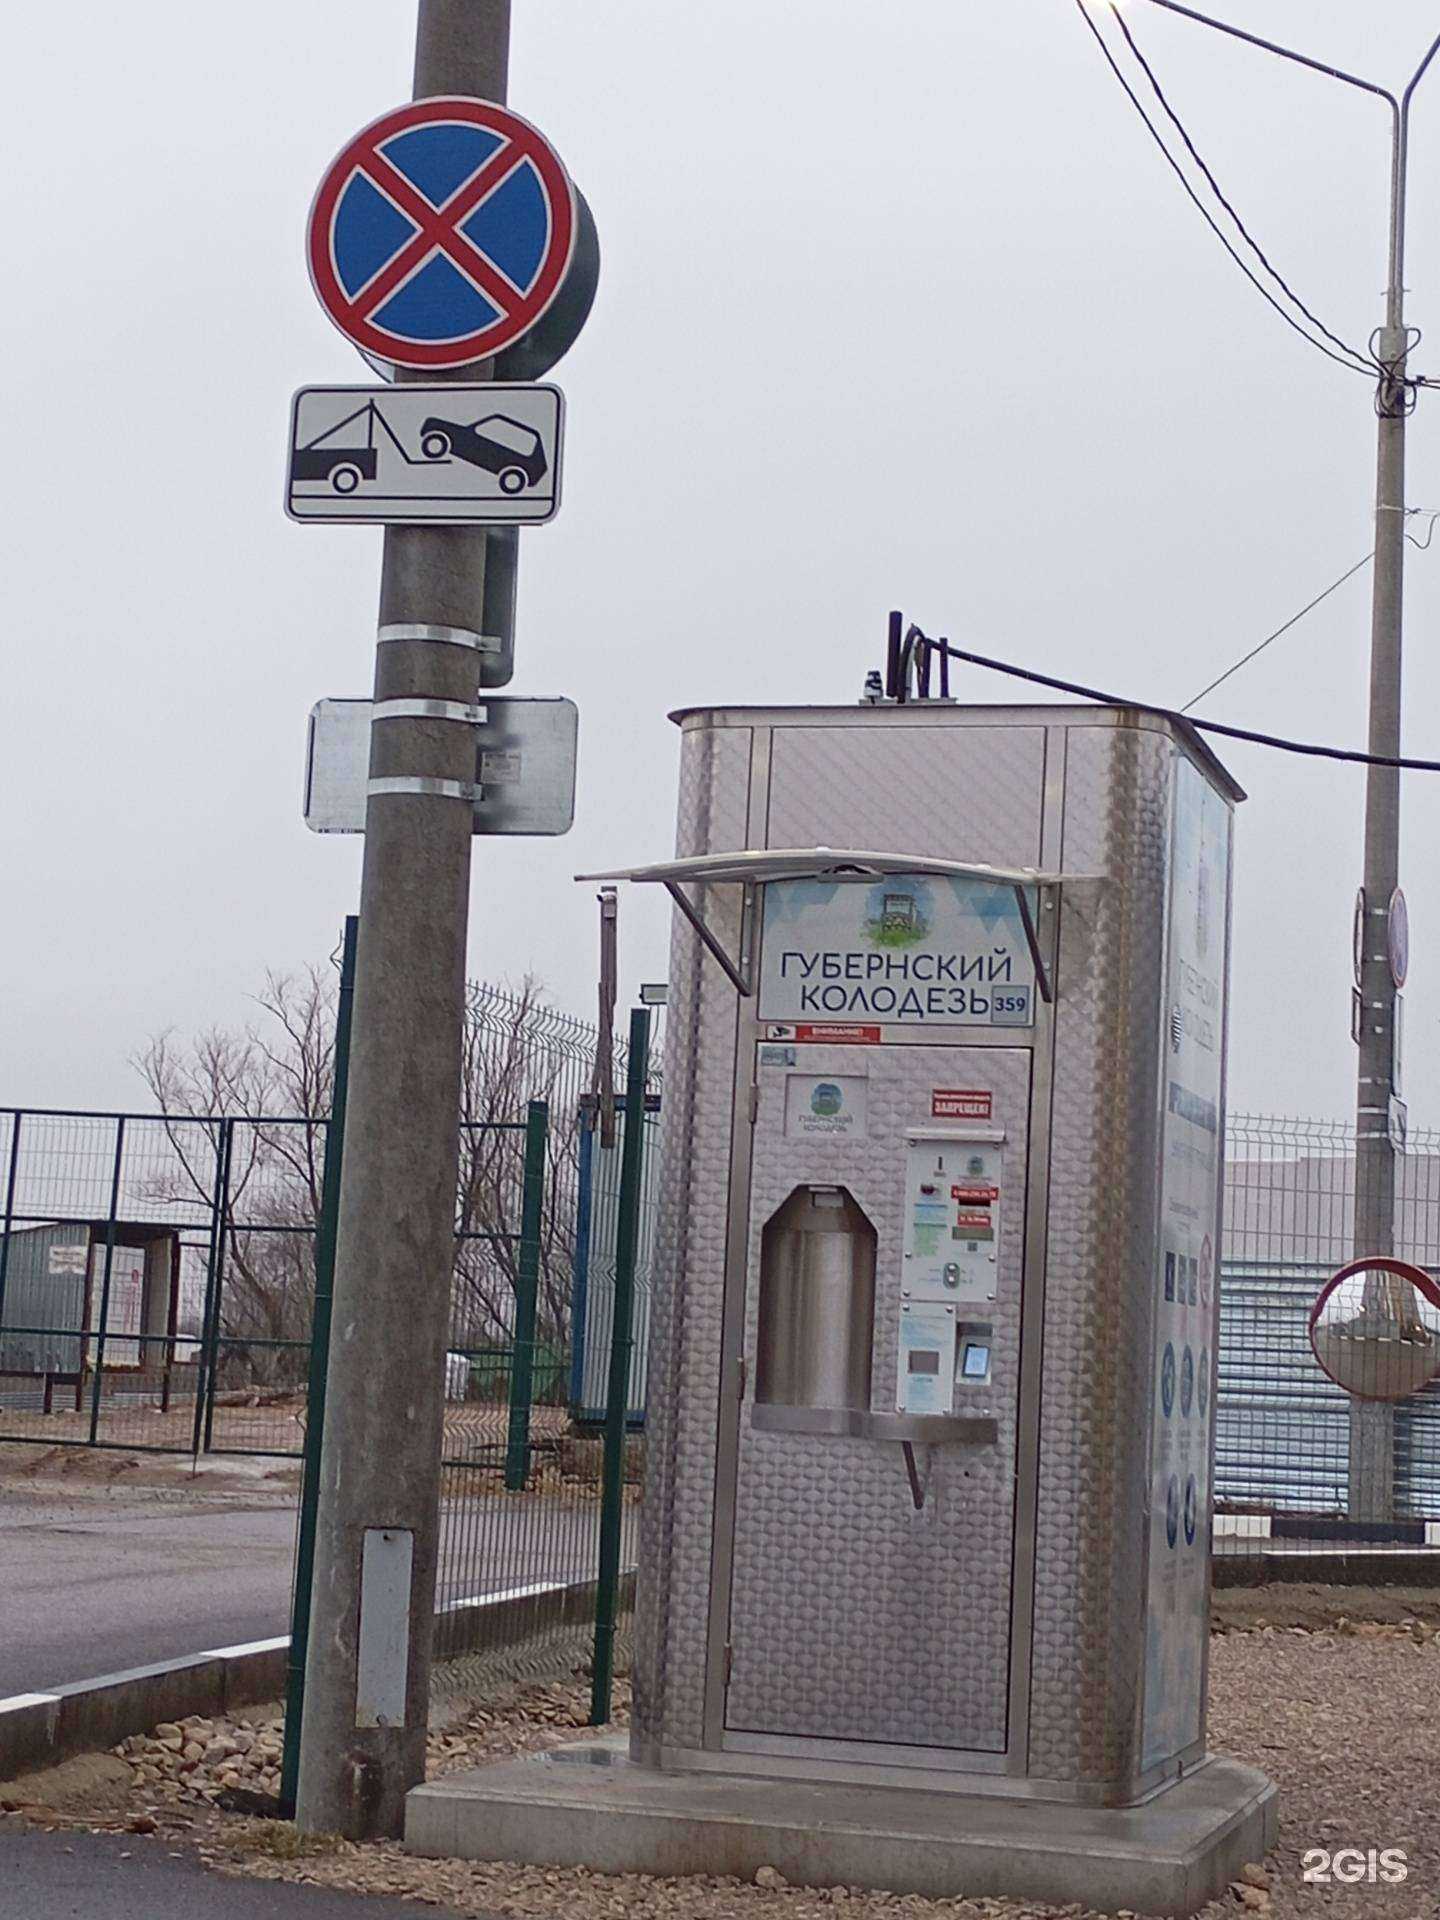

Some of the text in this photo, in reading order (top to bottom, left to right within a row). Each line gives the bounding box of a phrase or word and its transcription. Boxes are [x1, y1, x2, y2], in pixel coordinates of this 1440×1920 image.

[781, 947, 1012, 982] ГУБЕРНСКИЙ
[801, 985, 989, 1019] КОЛОДЕЗЬ
[994, 997, 1026, 1012] 359
